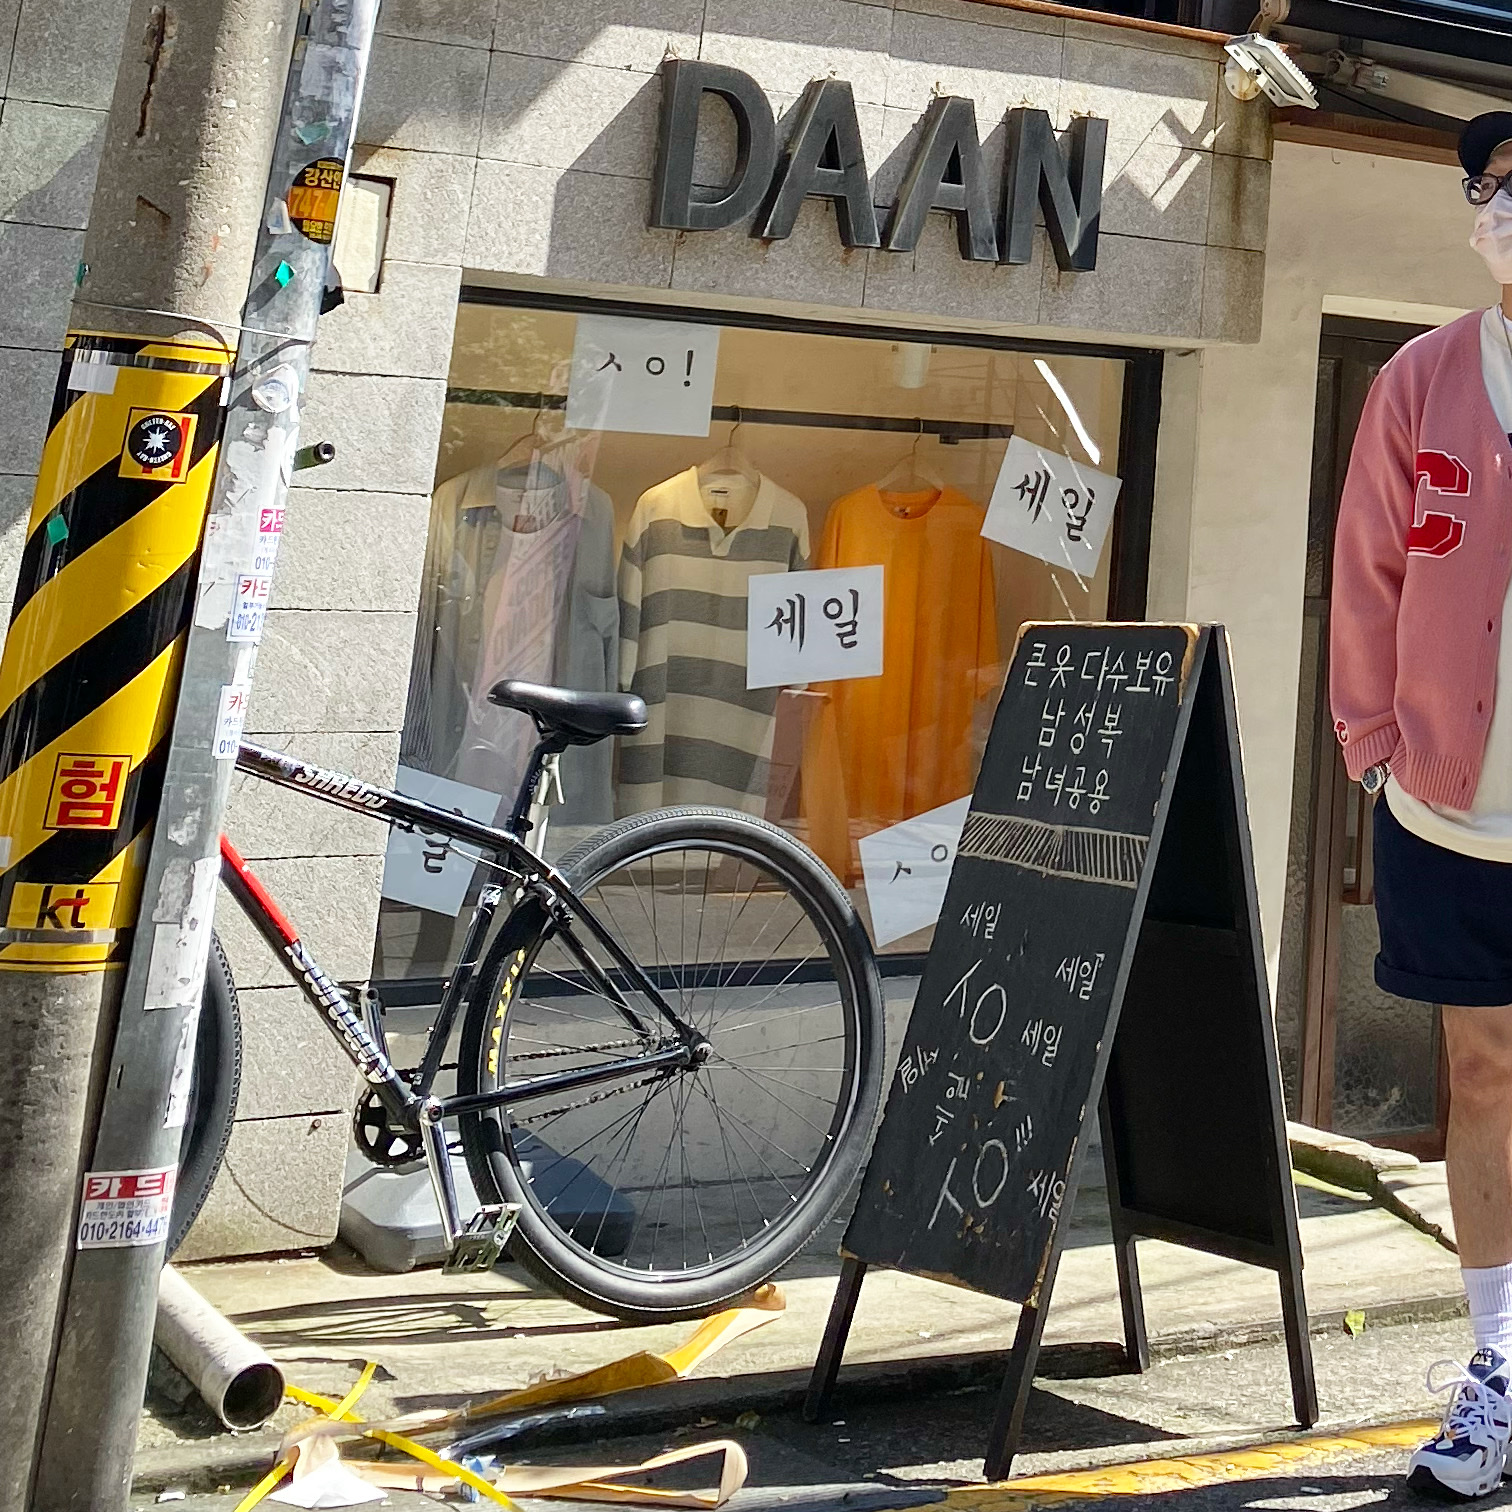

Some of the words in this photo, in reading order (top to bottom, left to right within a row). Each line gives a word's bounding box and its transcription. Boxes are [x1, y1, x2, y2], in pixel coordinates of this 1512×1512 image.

[650, 59, 1108, 271] DAAN
[1011, 470, 1096, 541] 세일
[764, 589, 860, 653] 세일
[1038, 697, 1123, 759] 남성복
[56, 761, 124, 827] 험
[1017, 752, 1110, 814] 남녀공용
[36, 886, 90, 928] kt
[960, 901, 1001, 939] 세일
[1055, 954, 1105, 1000] 세일
[1021, 1019, 1063, 1067] 세일
[89, 1174, 163, 1198] 카드
